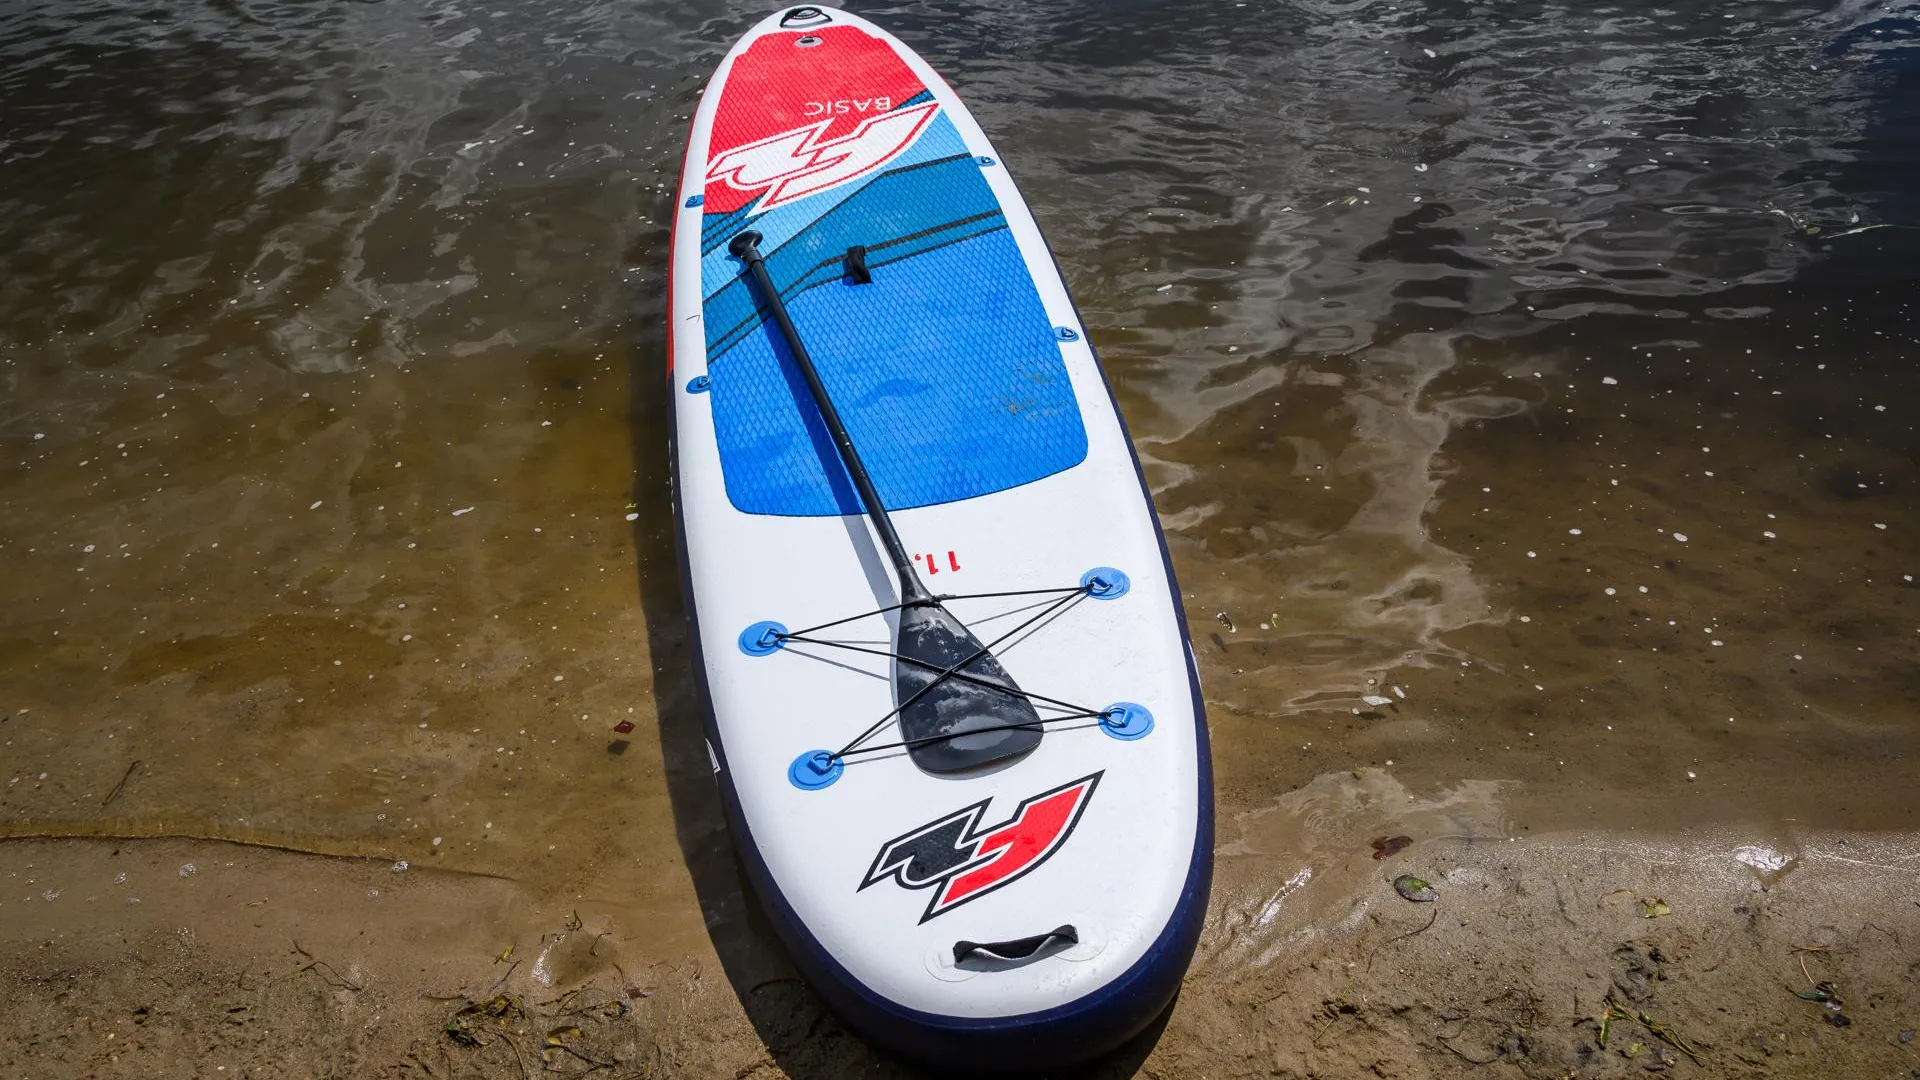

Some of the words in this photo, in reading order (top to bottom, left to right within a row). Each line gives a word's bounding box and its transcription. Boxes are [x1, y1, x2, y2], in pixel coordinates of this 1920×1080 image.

[804, 96, 891, 116] BASIC
[911, 550, 961, 576] 11,
[856, 769, 1106, 926] F2
